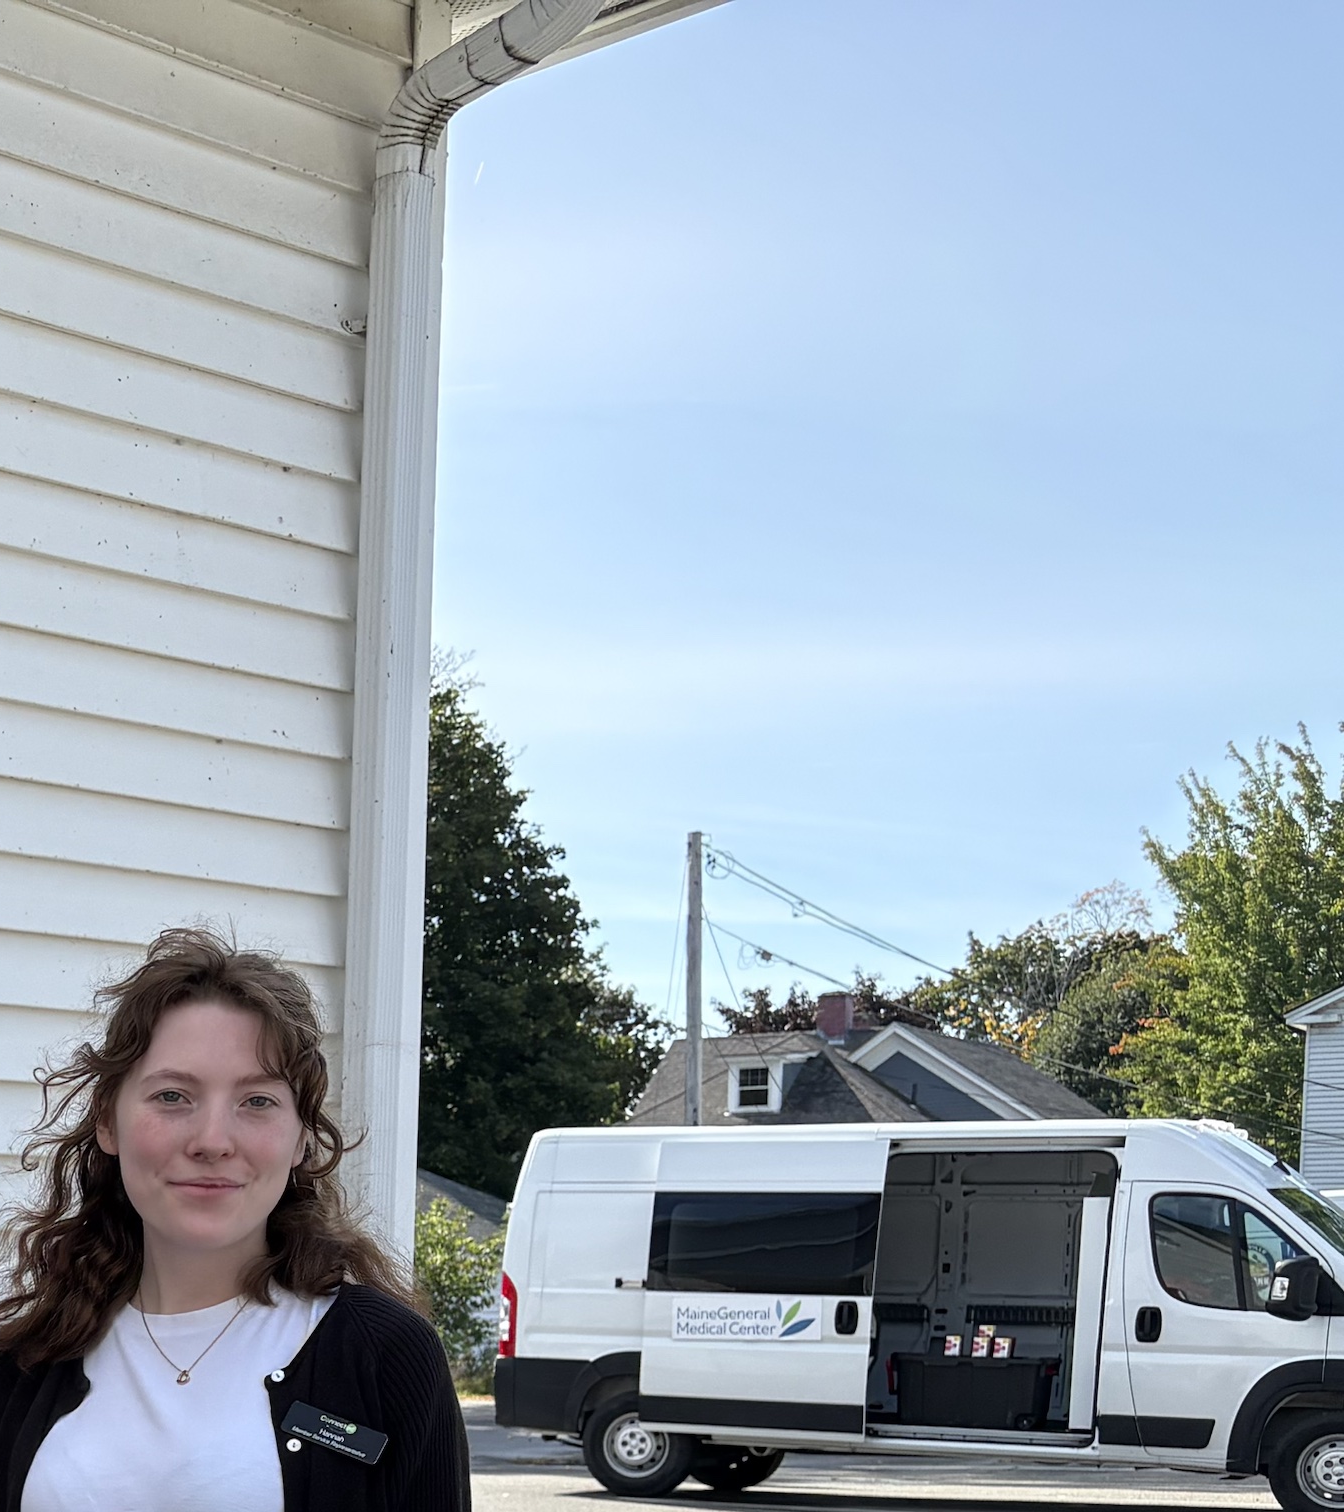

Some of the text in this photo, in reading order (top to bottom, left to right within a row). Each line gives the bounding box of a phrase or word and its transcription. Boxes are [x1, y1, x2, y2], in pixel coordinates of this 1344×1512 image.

[675, 1306, 770, 1320] MaineGeneral
[675, 1322, 777, 1336] Medical Center
